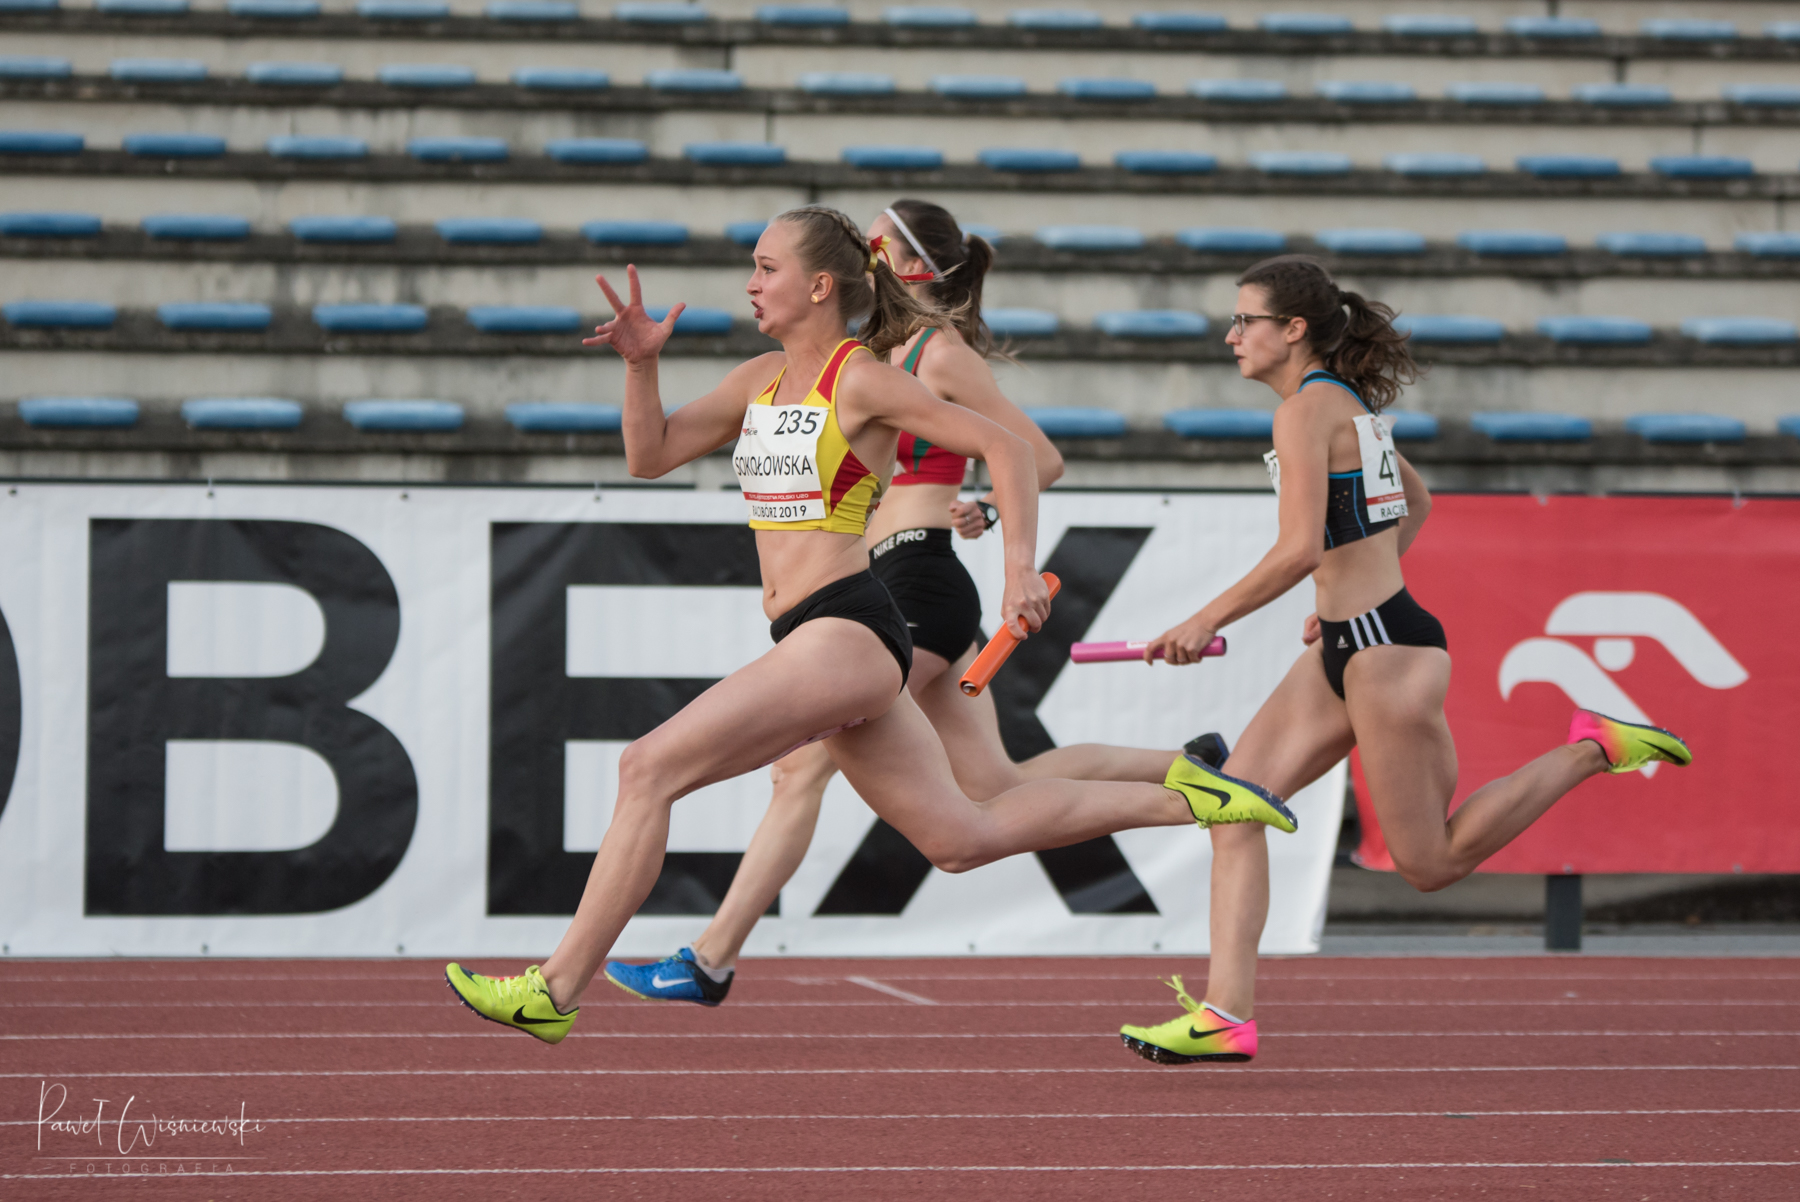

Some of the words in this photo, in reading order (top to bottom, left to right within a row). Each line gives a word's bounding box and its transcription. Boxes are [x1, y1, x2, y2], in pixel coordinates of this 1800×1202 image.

[774, 410, 820, 435] 235
[735, 455, 813, 476] SOKOŁOWSKA
[779, 505, 807, 518] 2019
[873, 536, 895, 559] NIKE
[896, 529, 927, 545] PRO
